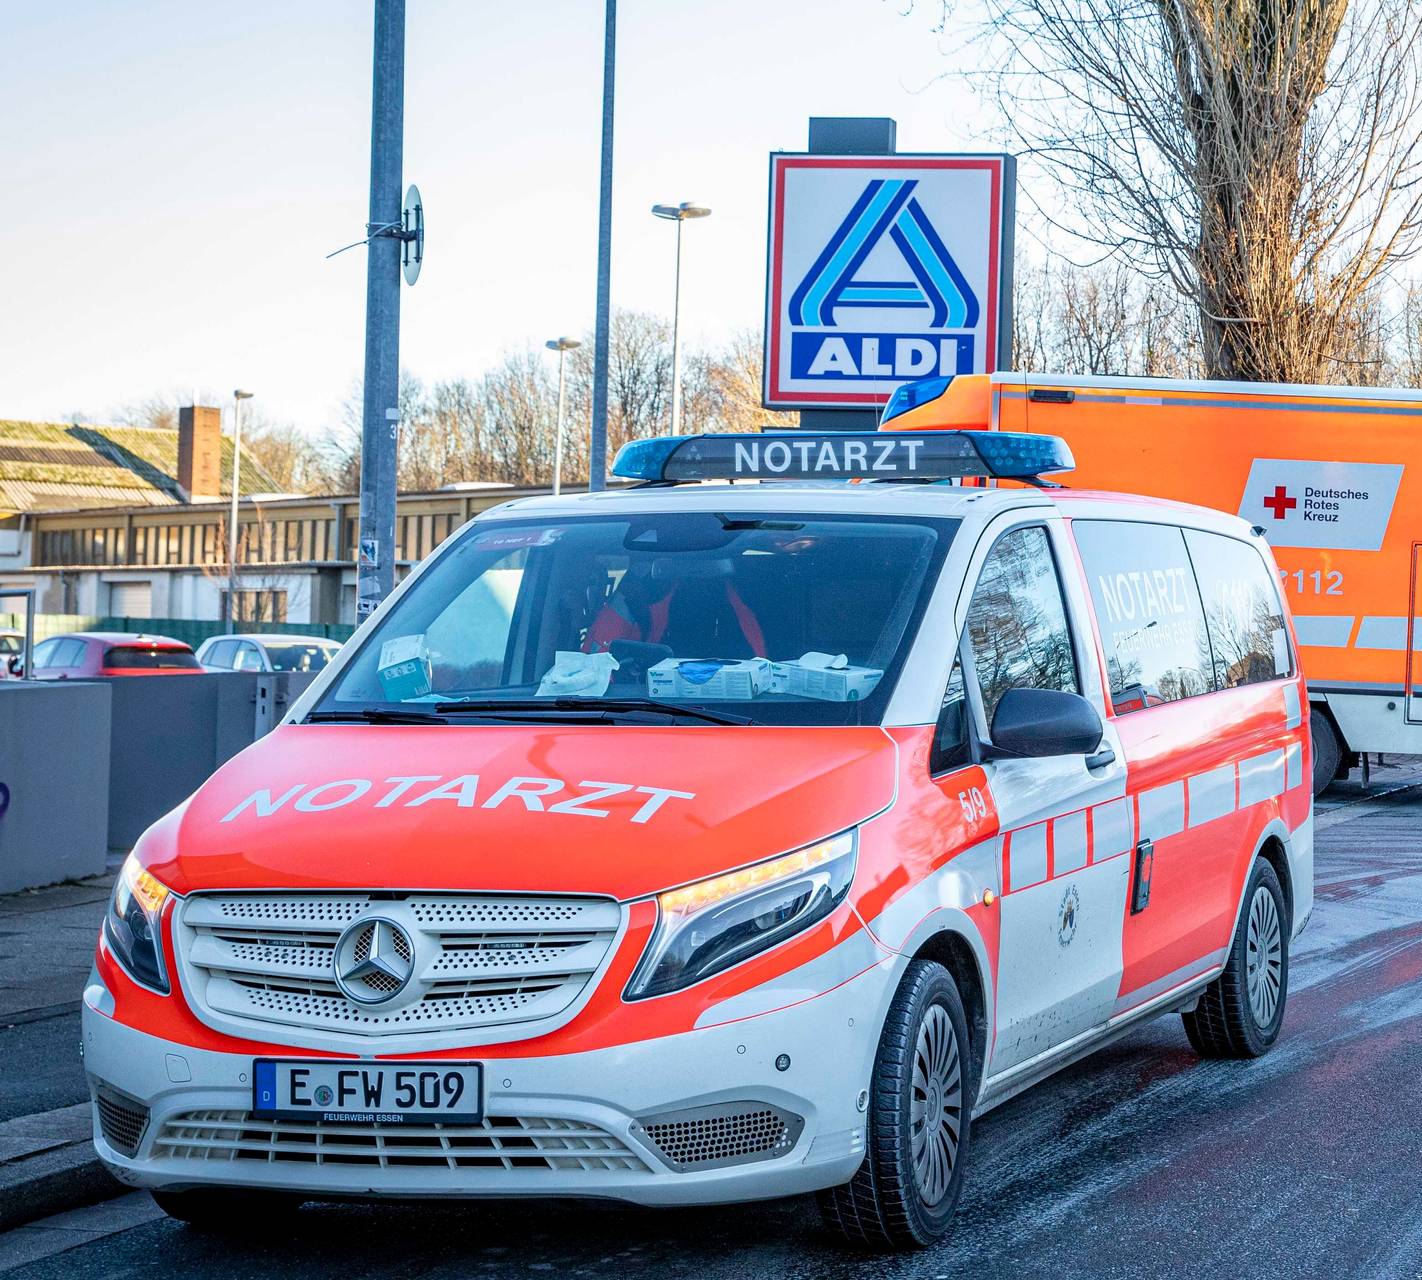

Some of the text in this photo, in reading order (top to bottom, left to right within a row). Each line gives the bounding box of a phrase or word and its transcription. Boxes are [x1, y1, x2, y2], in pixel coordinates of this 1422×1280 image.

[806, 336, 959, 377] ALDI
[734, 439, 925, 473] NOTARZT
[1303, 499, 1340, 511] Rotes
[1304, 487, 1369, 500] Deutsches
[1303, 511, 1340, 523] Kreuz
[1098, 567, 1193, 623] NOTARZT
[1292, 568, 1344, 596] 112
[219, 774, 697, 824] NOTARZT
[957, 786, 988, 823] 5/9
[263, 1090, 269, 1102] D
[289, 1068, 465, 1109] E FW 509
[323, 1112, 404, 1123] FEUERWEHR ESSEN
